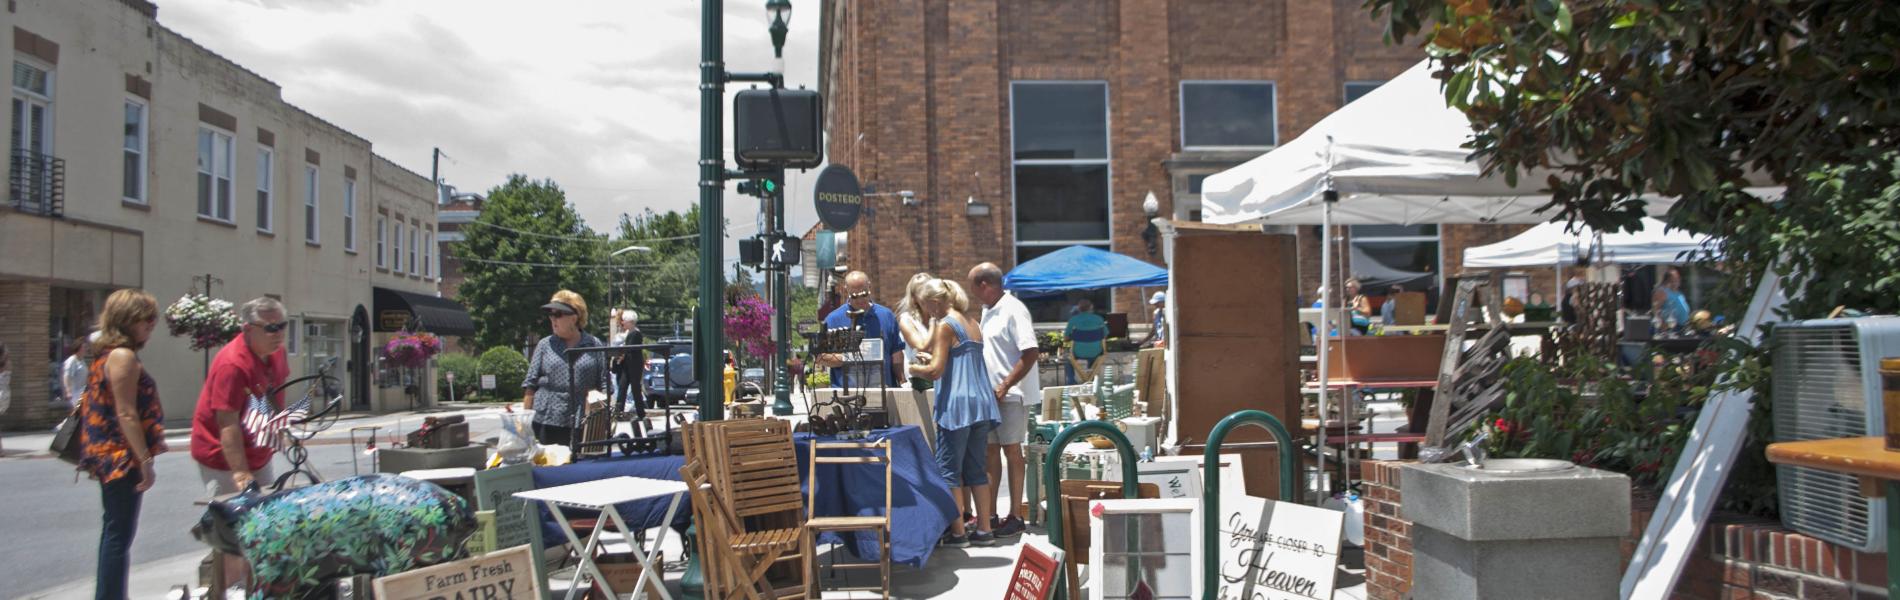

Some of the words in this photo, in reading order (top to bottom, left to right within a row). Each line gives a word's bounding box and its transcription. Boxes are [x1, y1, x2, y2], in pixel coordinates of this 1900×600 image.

[819, 192, 861, 204] POSTERO
[1277, 536, 1307, 552] CLOSER
[1313, 543, 1325, 557] TO
[425, 573, 467, 591] Farm
[470, 559, 513, 581] Fresh
[1222, 549, 1317, 597] Heaven
